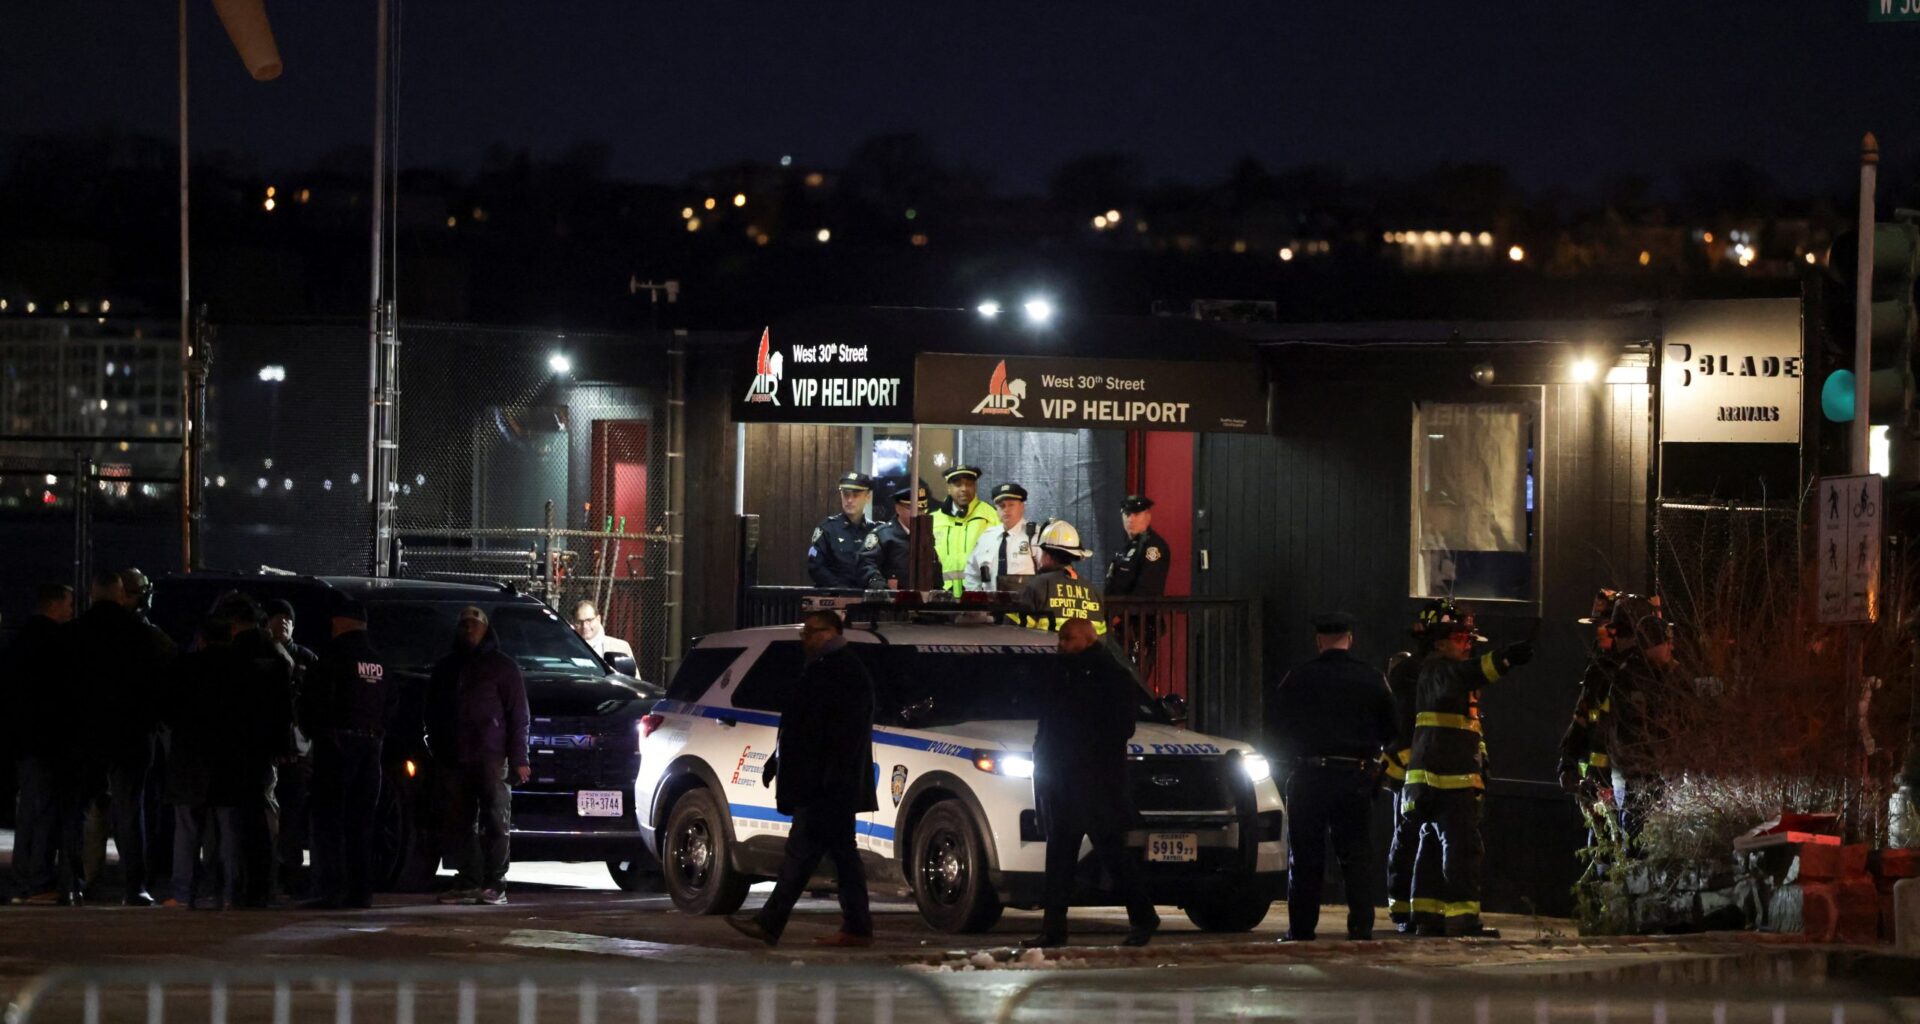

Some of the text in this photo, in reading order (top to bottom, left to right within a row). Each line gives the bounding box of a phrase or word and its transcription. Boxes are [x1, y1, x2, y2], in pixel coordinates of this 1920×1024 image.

[793, 344, 817, 363] West
[838, 343, 868, 363] Street
[1699, 354, 1800, 378] BLADE
[1041, 374, 1074, 389] West
[1105, 376, 1146, 391] Street
[791, 377, 900, 406] VIP HELIPORT
[1040, 398, 1190, 423] VIP HELIPORT
[1717, 406, 1780, 421] ARRIVALS
[1049, 597, 1076, 608] DEPUTY
[1062, 607, 1088, 619] LOFTUS
[915, 645, 1058, 655] HIGHWAY PATR
[358, 661, 383, 677] NYPD
[927, 740, 963, 757] POLICE
[1150, 743, 1221, 754] POLICE
[1153, 840, 1183, 855] 5919
